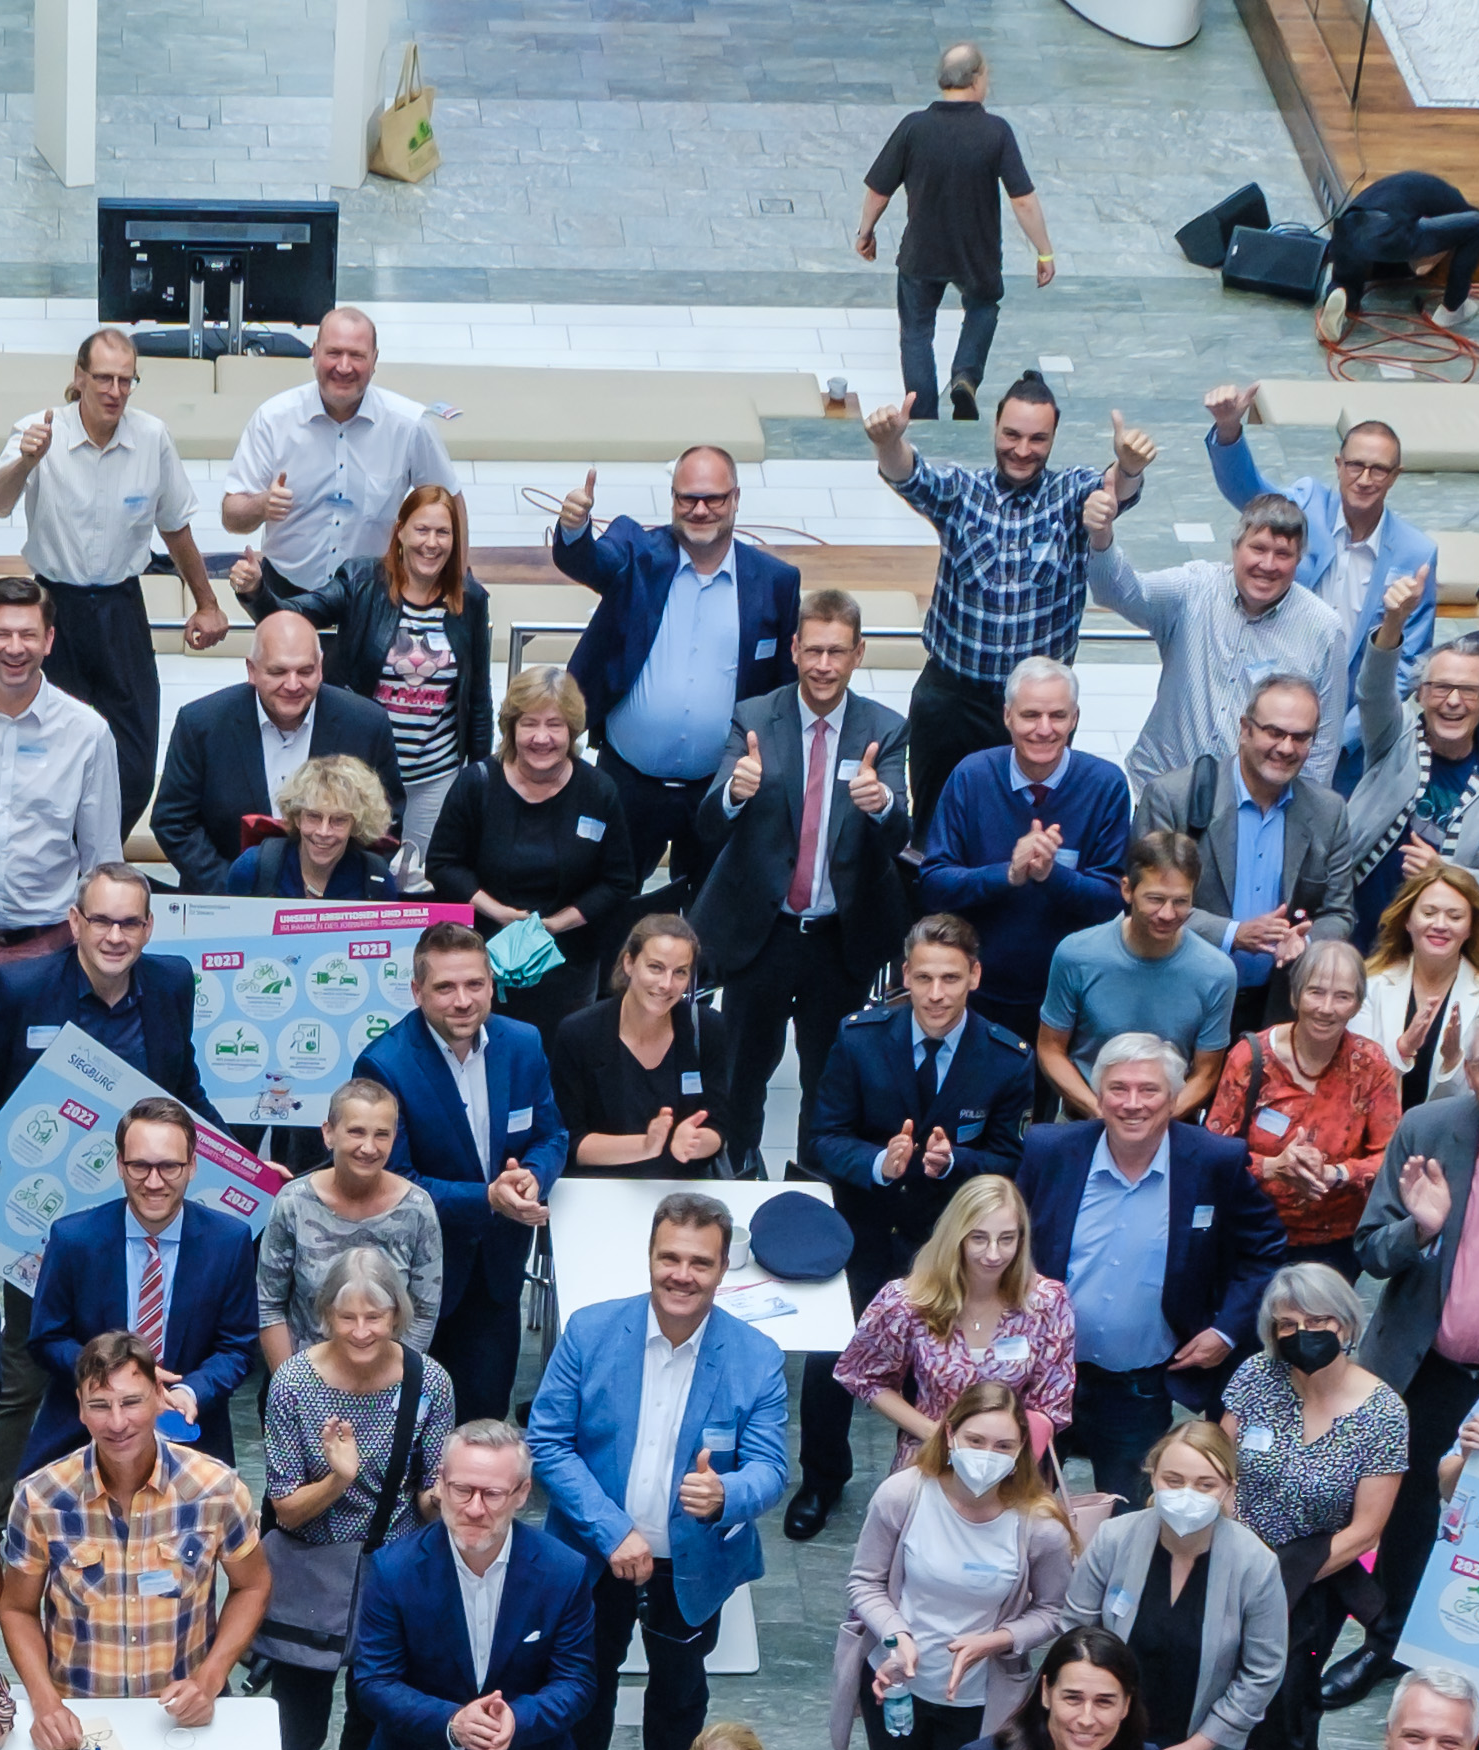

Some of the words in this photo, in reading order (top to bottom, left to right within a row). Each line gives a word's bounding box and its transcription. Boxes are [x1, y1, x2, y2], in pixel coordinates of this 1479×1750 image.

[381, 909, 401, 918] UND
[352, 943, 388, 957] 2025
[205, 954, 241, 968] 2023
[68, 1053, 117, 1092] SIEGBURG
[62, 1101, 96, 1126] 2022
